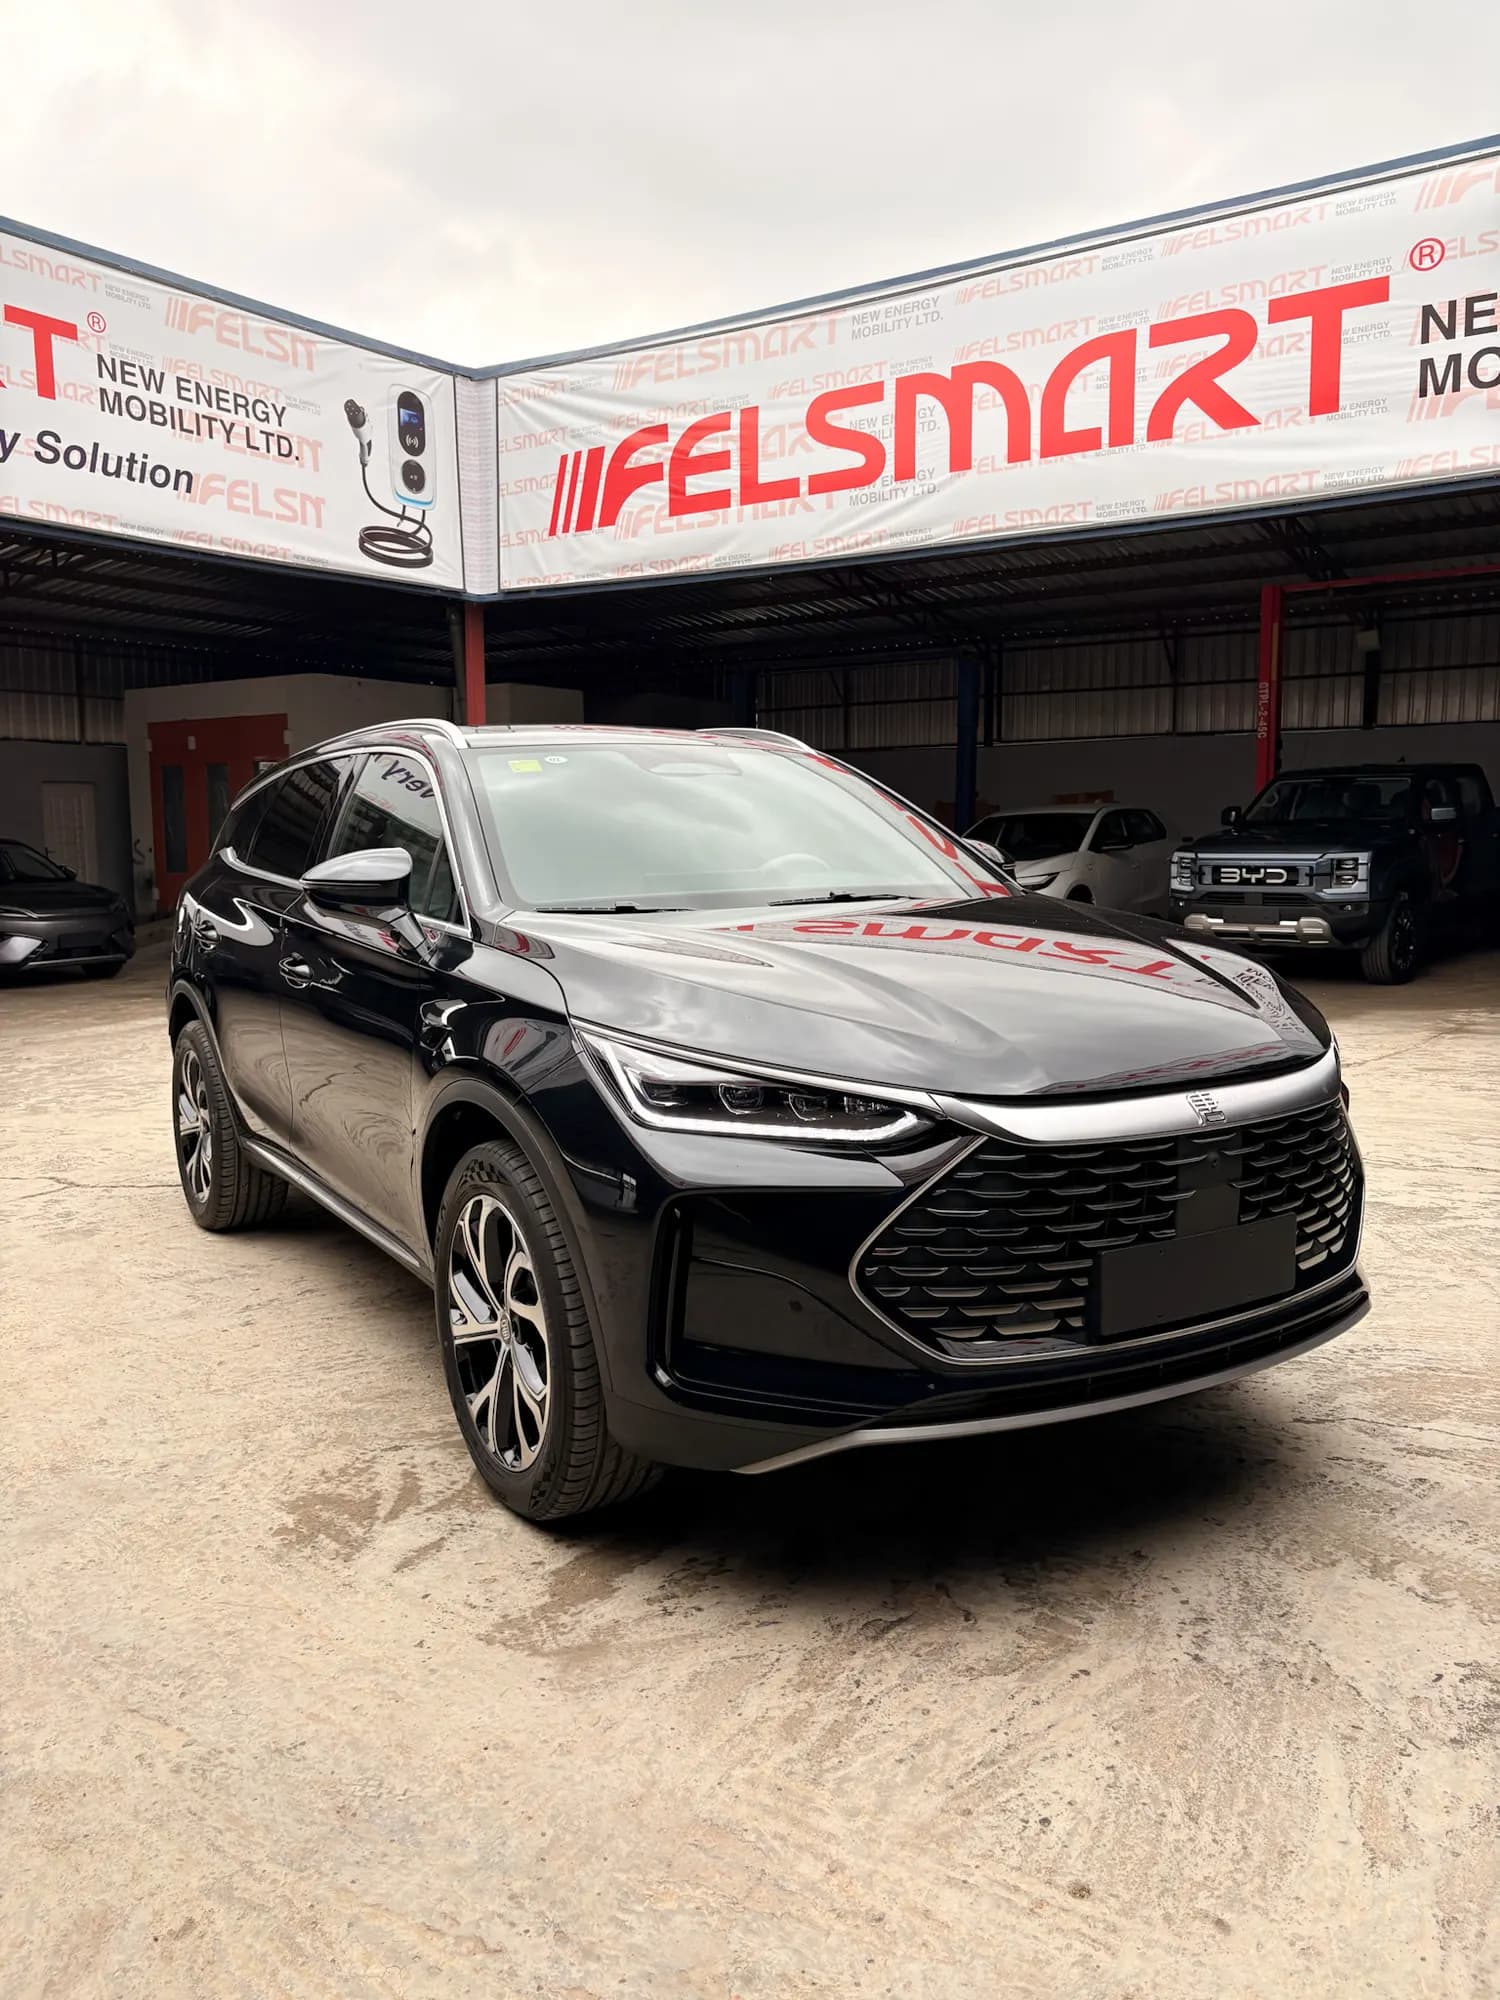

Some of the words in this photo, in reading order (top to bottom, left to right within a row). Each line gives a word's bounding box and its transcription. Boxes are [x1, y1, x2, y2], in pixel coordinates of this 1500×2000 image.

[851, 310, 881, 326] NEW
[884, 296, 940, 319] ENERGY
[851, 317, 912, 341] MOBILITY
[915, 310, 943, 326] LTD.
[0, 304, 78, 400] T
[97, 353, 165, 394] NEW
[176, 376, 286, 427] ENERGY
[99, 387, 236, 444] MOBILITY
[245, 426, 299, 461] LTD.
[34, 430, 194, 494] Solution
[849, 487, 908, 507] MOBILITY
[1220, 868, 1288, 884] BYD
